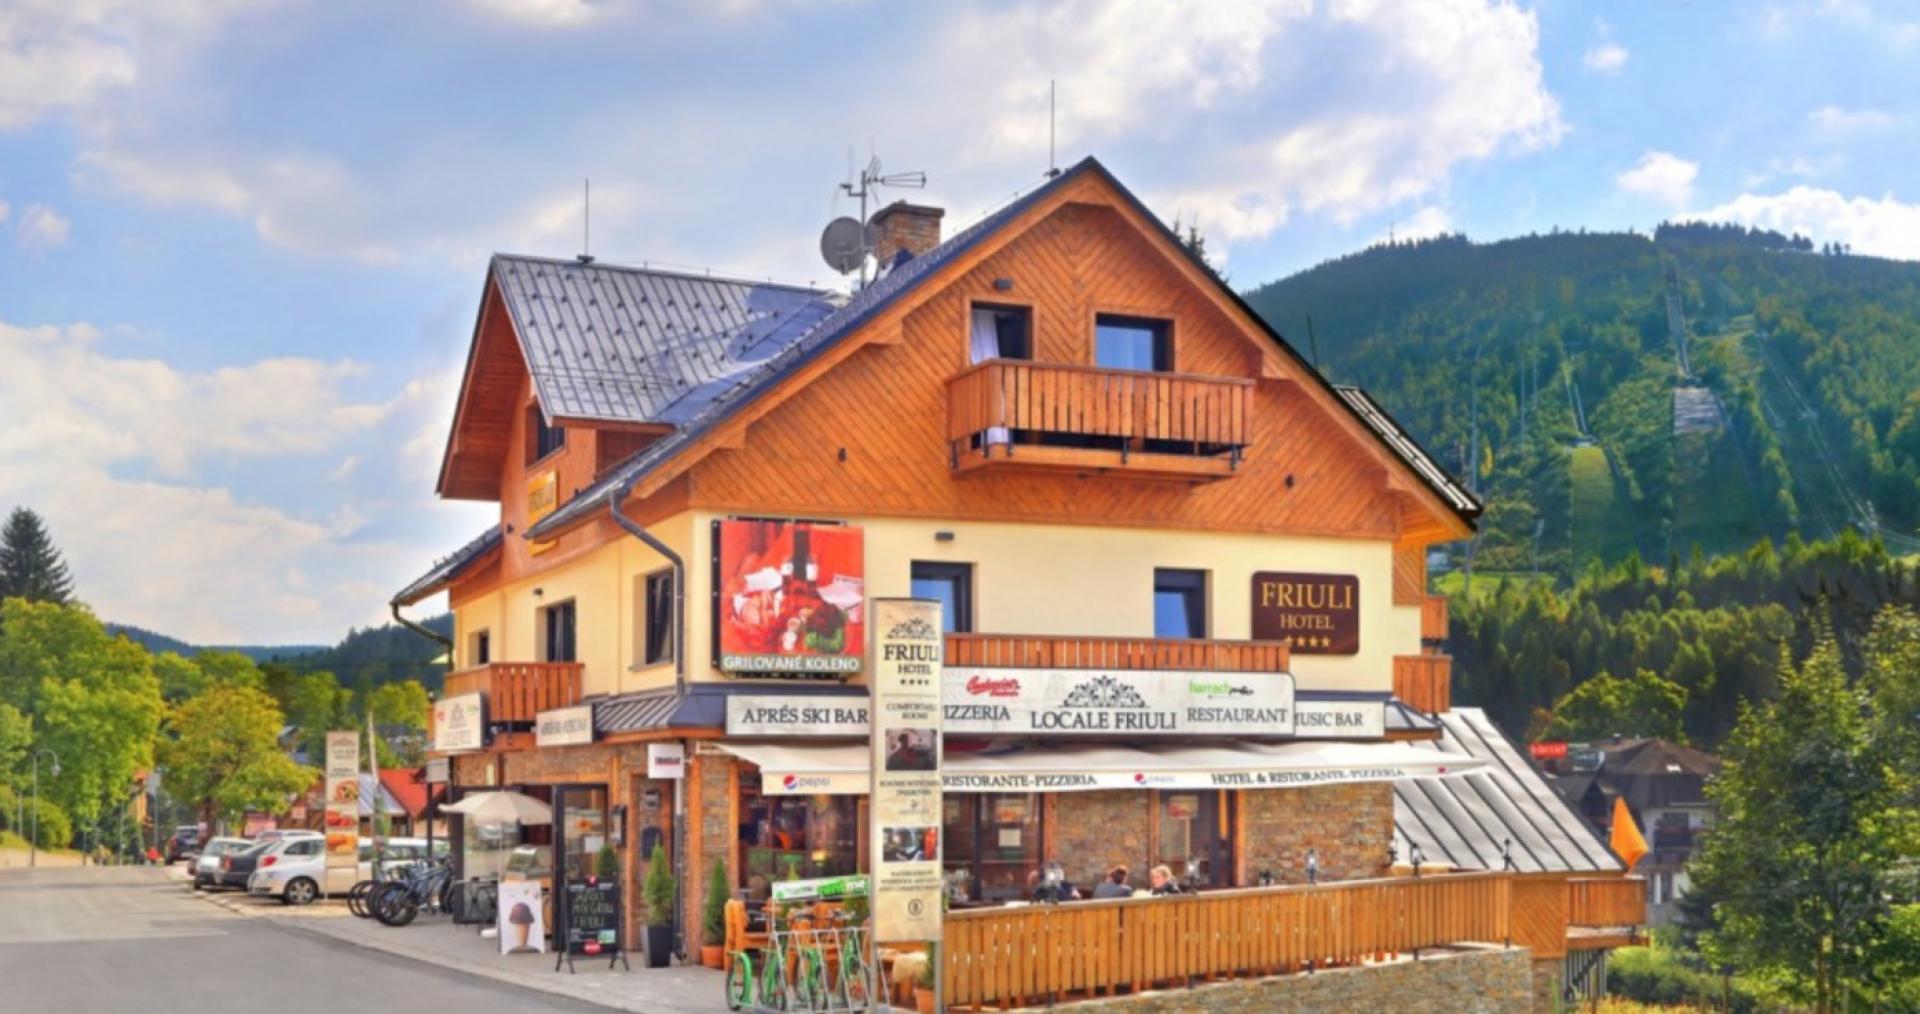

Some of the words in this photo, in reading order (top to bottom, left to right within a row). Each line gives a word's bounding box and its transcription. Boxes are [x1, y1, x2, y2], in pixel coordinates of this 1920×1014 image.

[1261, 582, 1353, 608] FRIULI
[1280, 613, 1334, 629] HOTEL
[723, 653, 802, 670] GRILOVANÉ
[805, 657, 860, 670] KOLENO
[742, 704, 798, 724] APRÉS
[801, 708, 830, 724] SKI
[834, 708, 868, 724] BAR
[943, 704, 1011, 721] IZZERIA
[1030, 710, 1109, 730] LOCALE
[1115, 711, 1177, 730] FRIULI
[1187, 707, 1288, 723] RESTAURANT
[1335, 712, 1363, 726] BAR
[943, 774, 1098, 787] RISTORANTE-PIZZERIA
[1211, 773, 1254, 785] HOTEL
[1256, 774, 1266, 783] &
